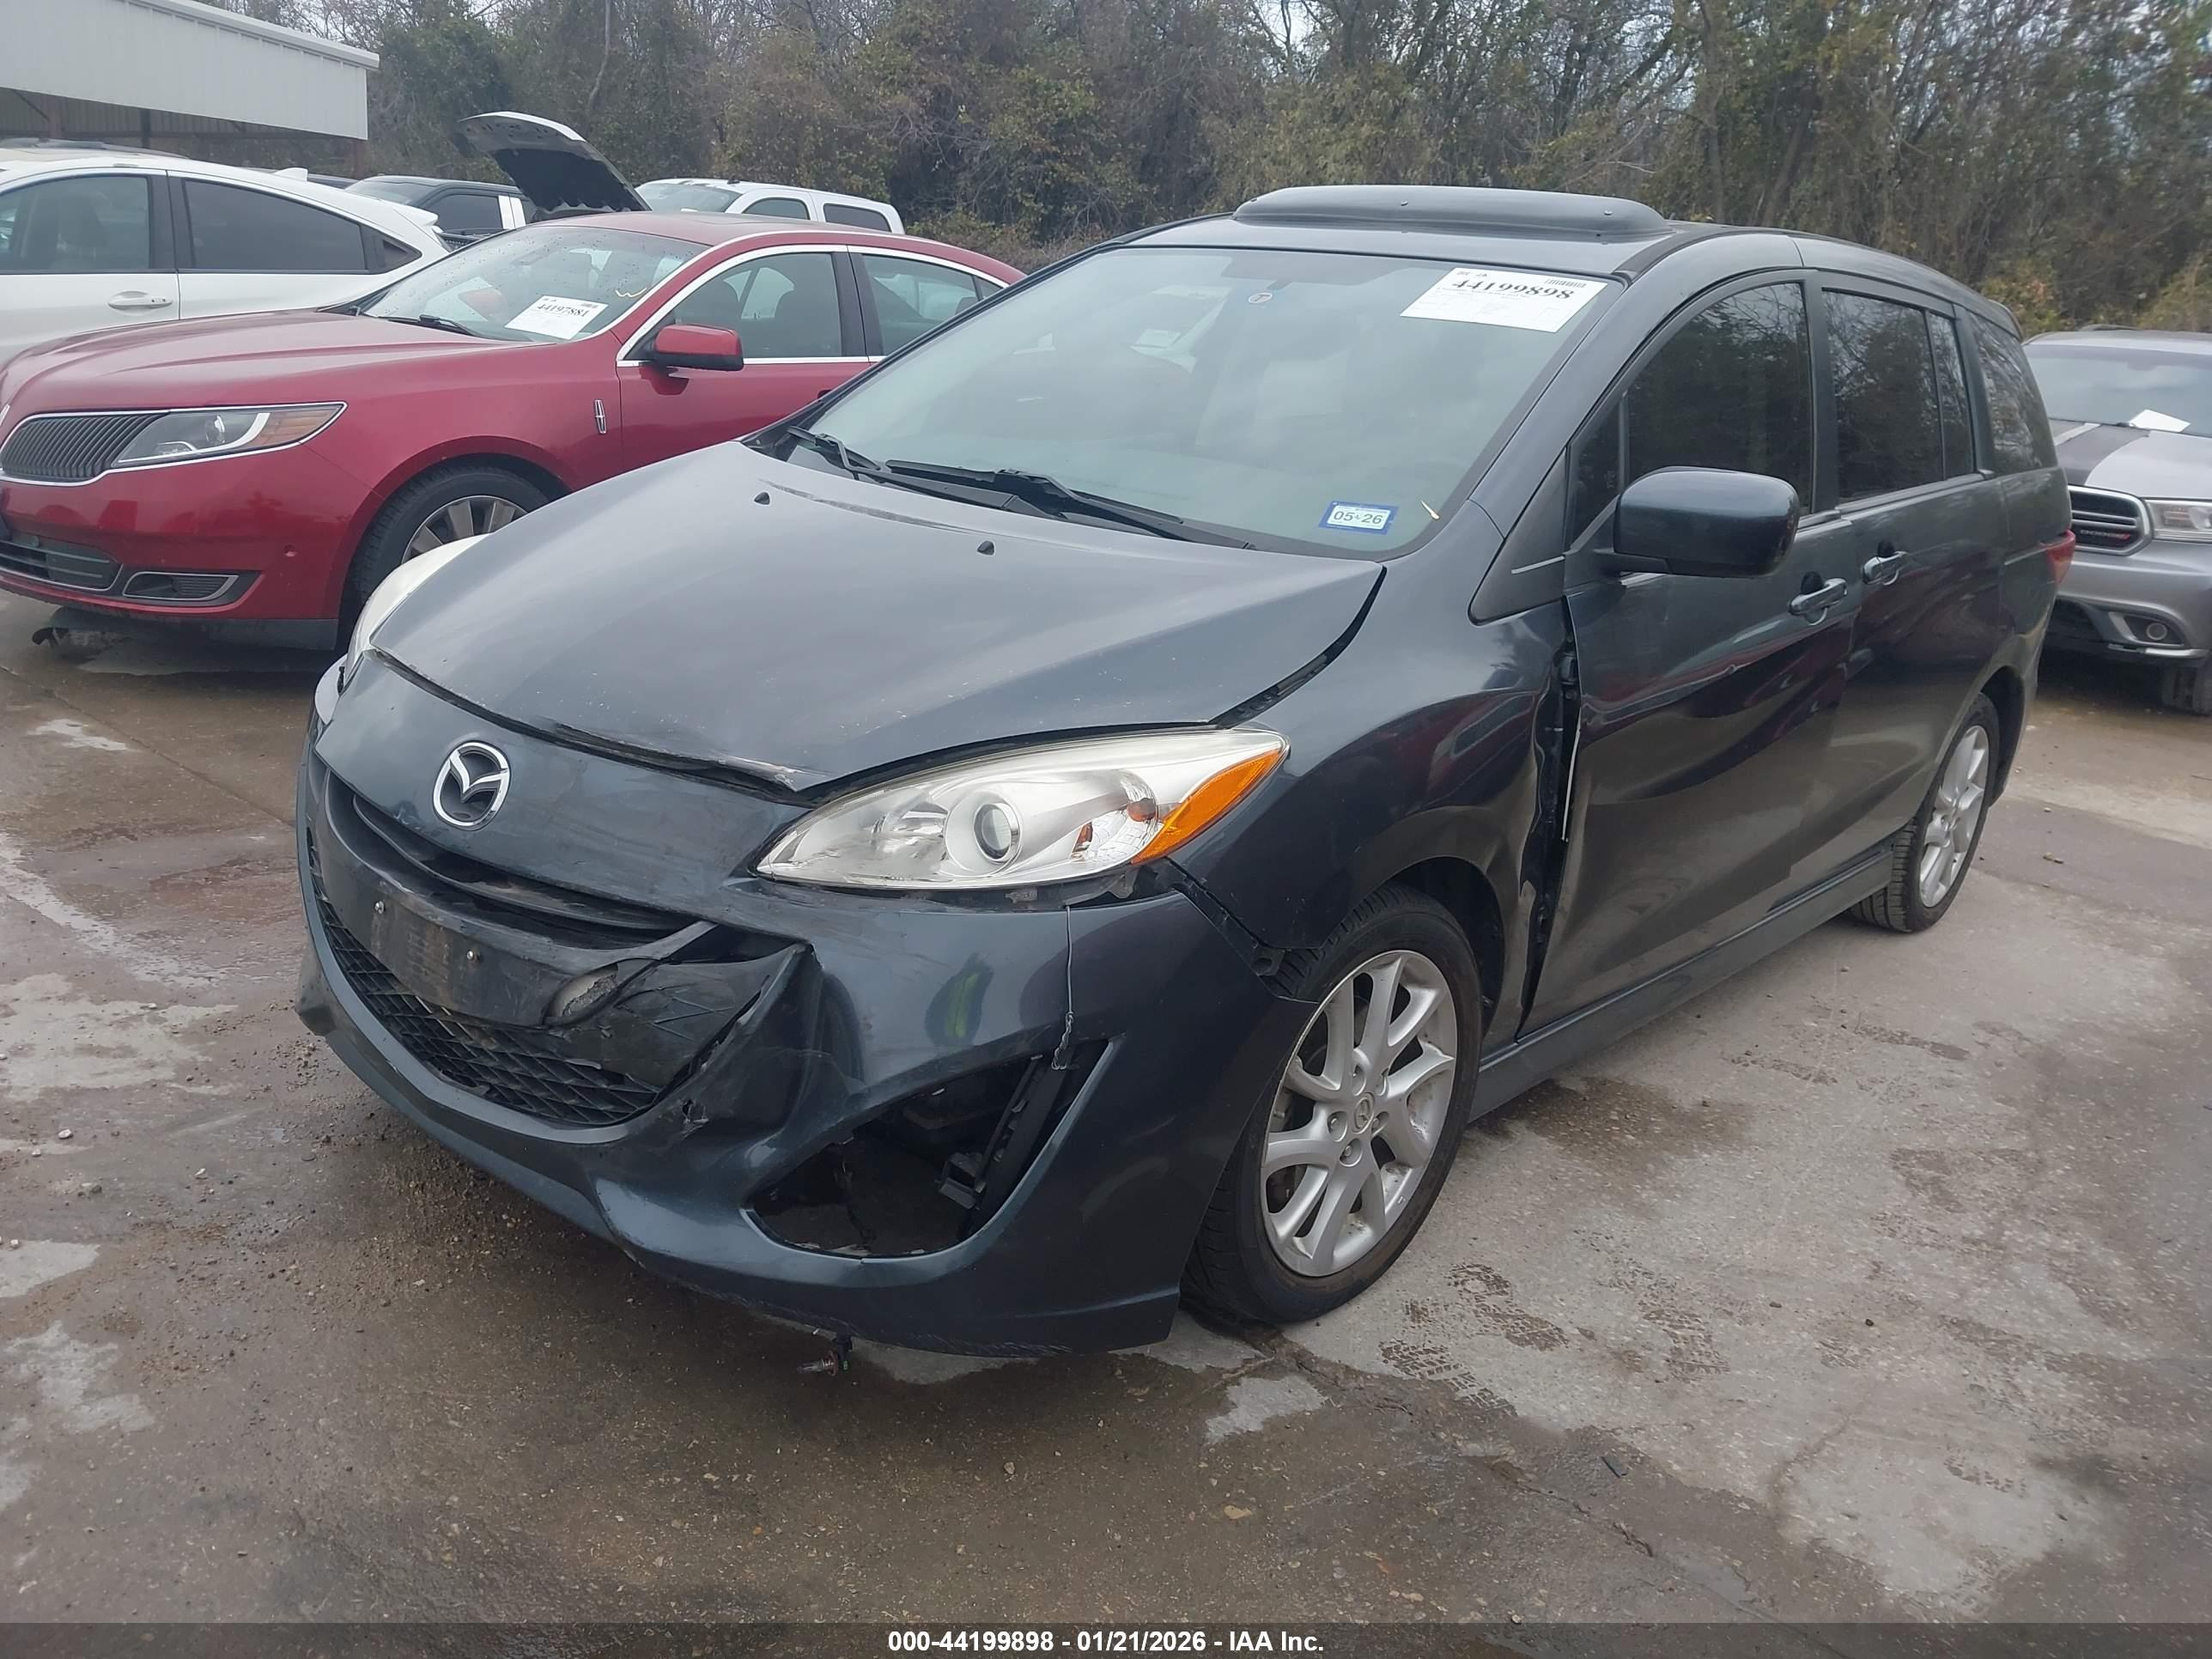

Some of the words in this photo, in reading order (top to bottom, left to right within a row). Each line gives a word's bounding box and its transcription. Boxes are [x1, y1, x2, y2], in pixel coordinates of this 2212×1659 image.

[1452, 279, 1575, 300] 44199898
[538, 303, 590, 317] 44197881
[1334, 511, 1355, 521] 05
[1361, 514, 1383, 525] 26
